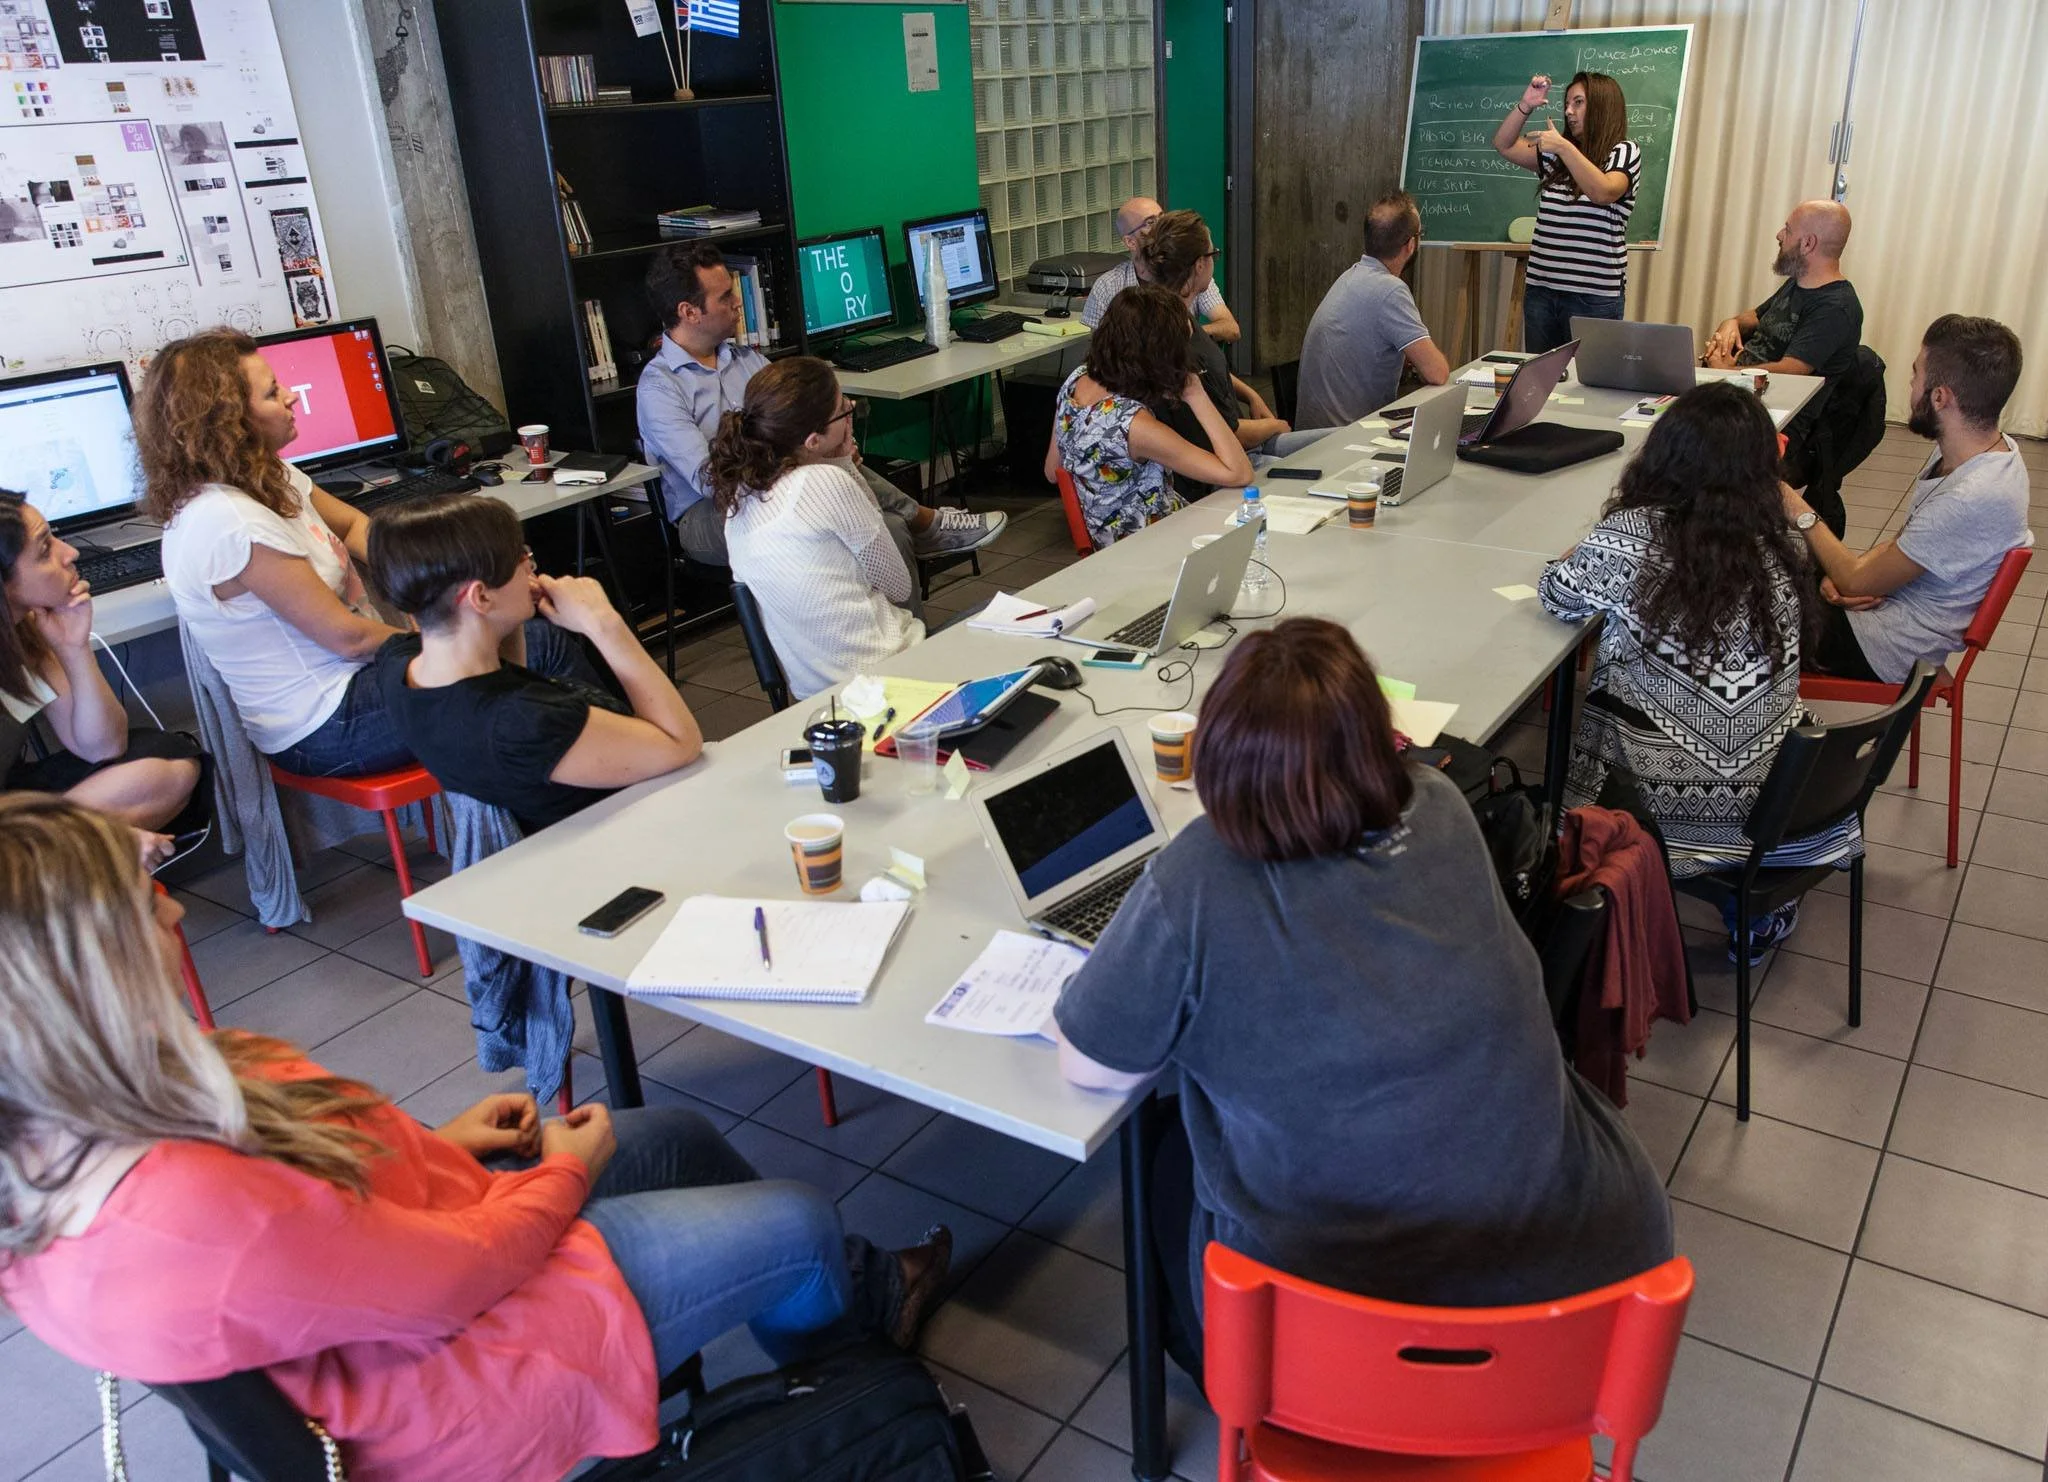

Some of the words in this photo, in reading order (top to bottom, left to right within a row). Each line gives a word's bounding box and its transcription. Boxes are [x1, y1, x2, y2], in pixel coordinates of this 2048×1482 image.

[811, 245, 849, 272] THE
[840, 271, 853, 294] O
[844, 294, 867, 320] RY
